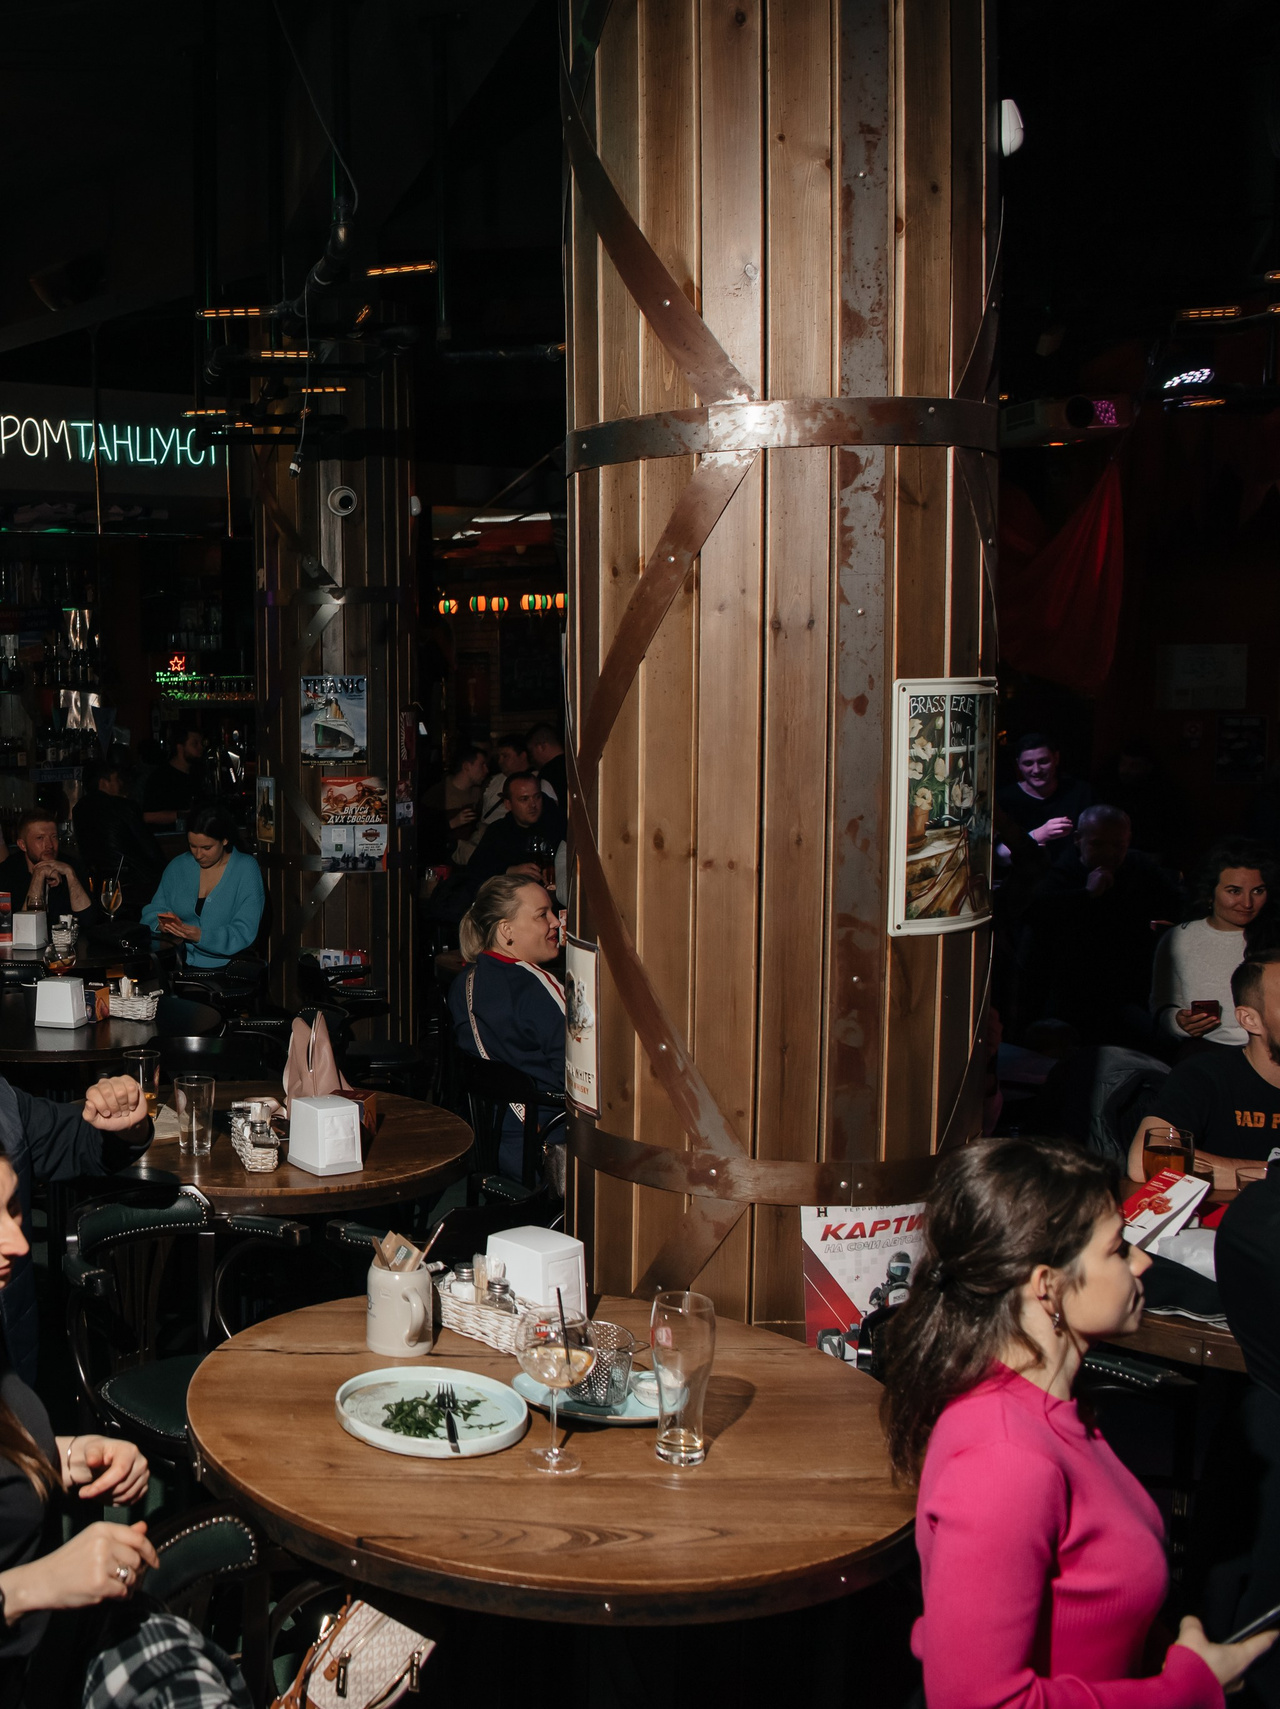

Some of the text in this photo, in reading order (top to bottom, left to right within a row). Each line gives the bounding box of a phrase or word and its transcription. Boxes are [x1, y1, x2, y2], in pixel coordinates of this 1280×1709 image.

[302, 678, 365, 694] TITANIC
[824, 1243, 843, 1254] НА
[846, 1239, 882, 1252] СОЧИ
